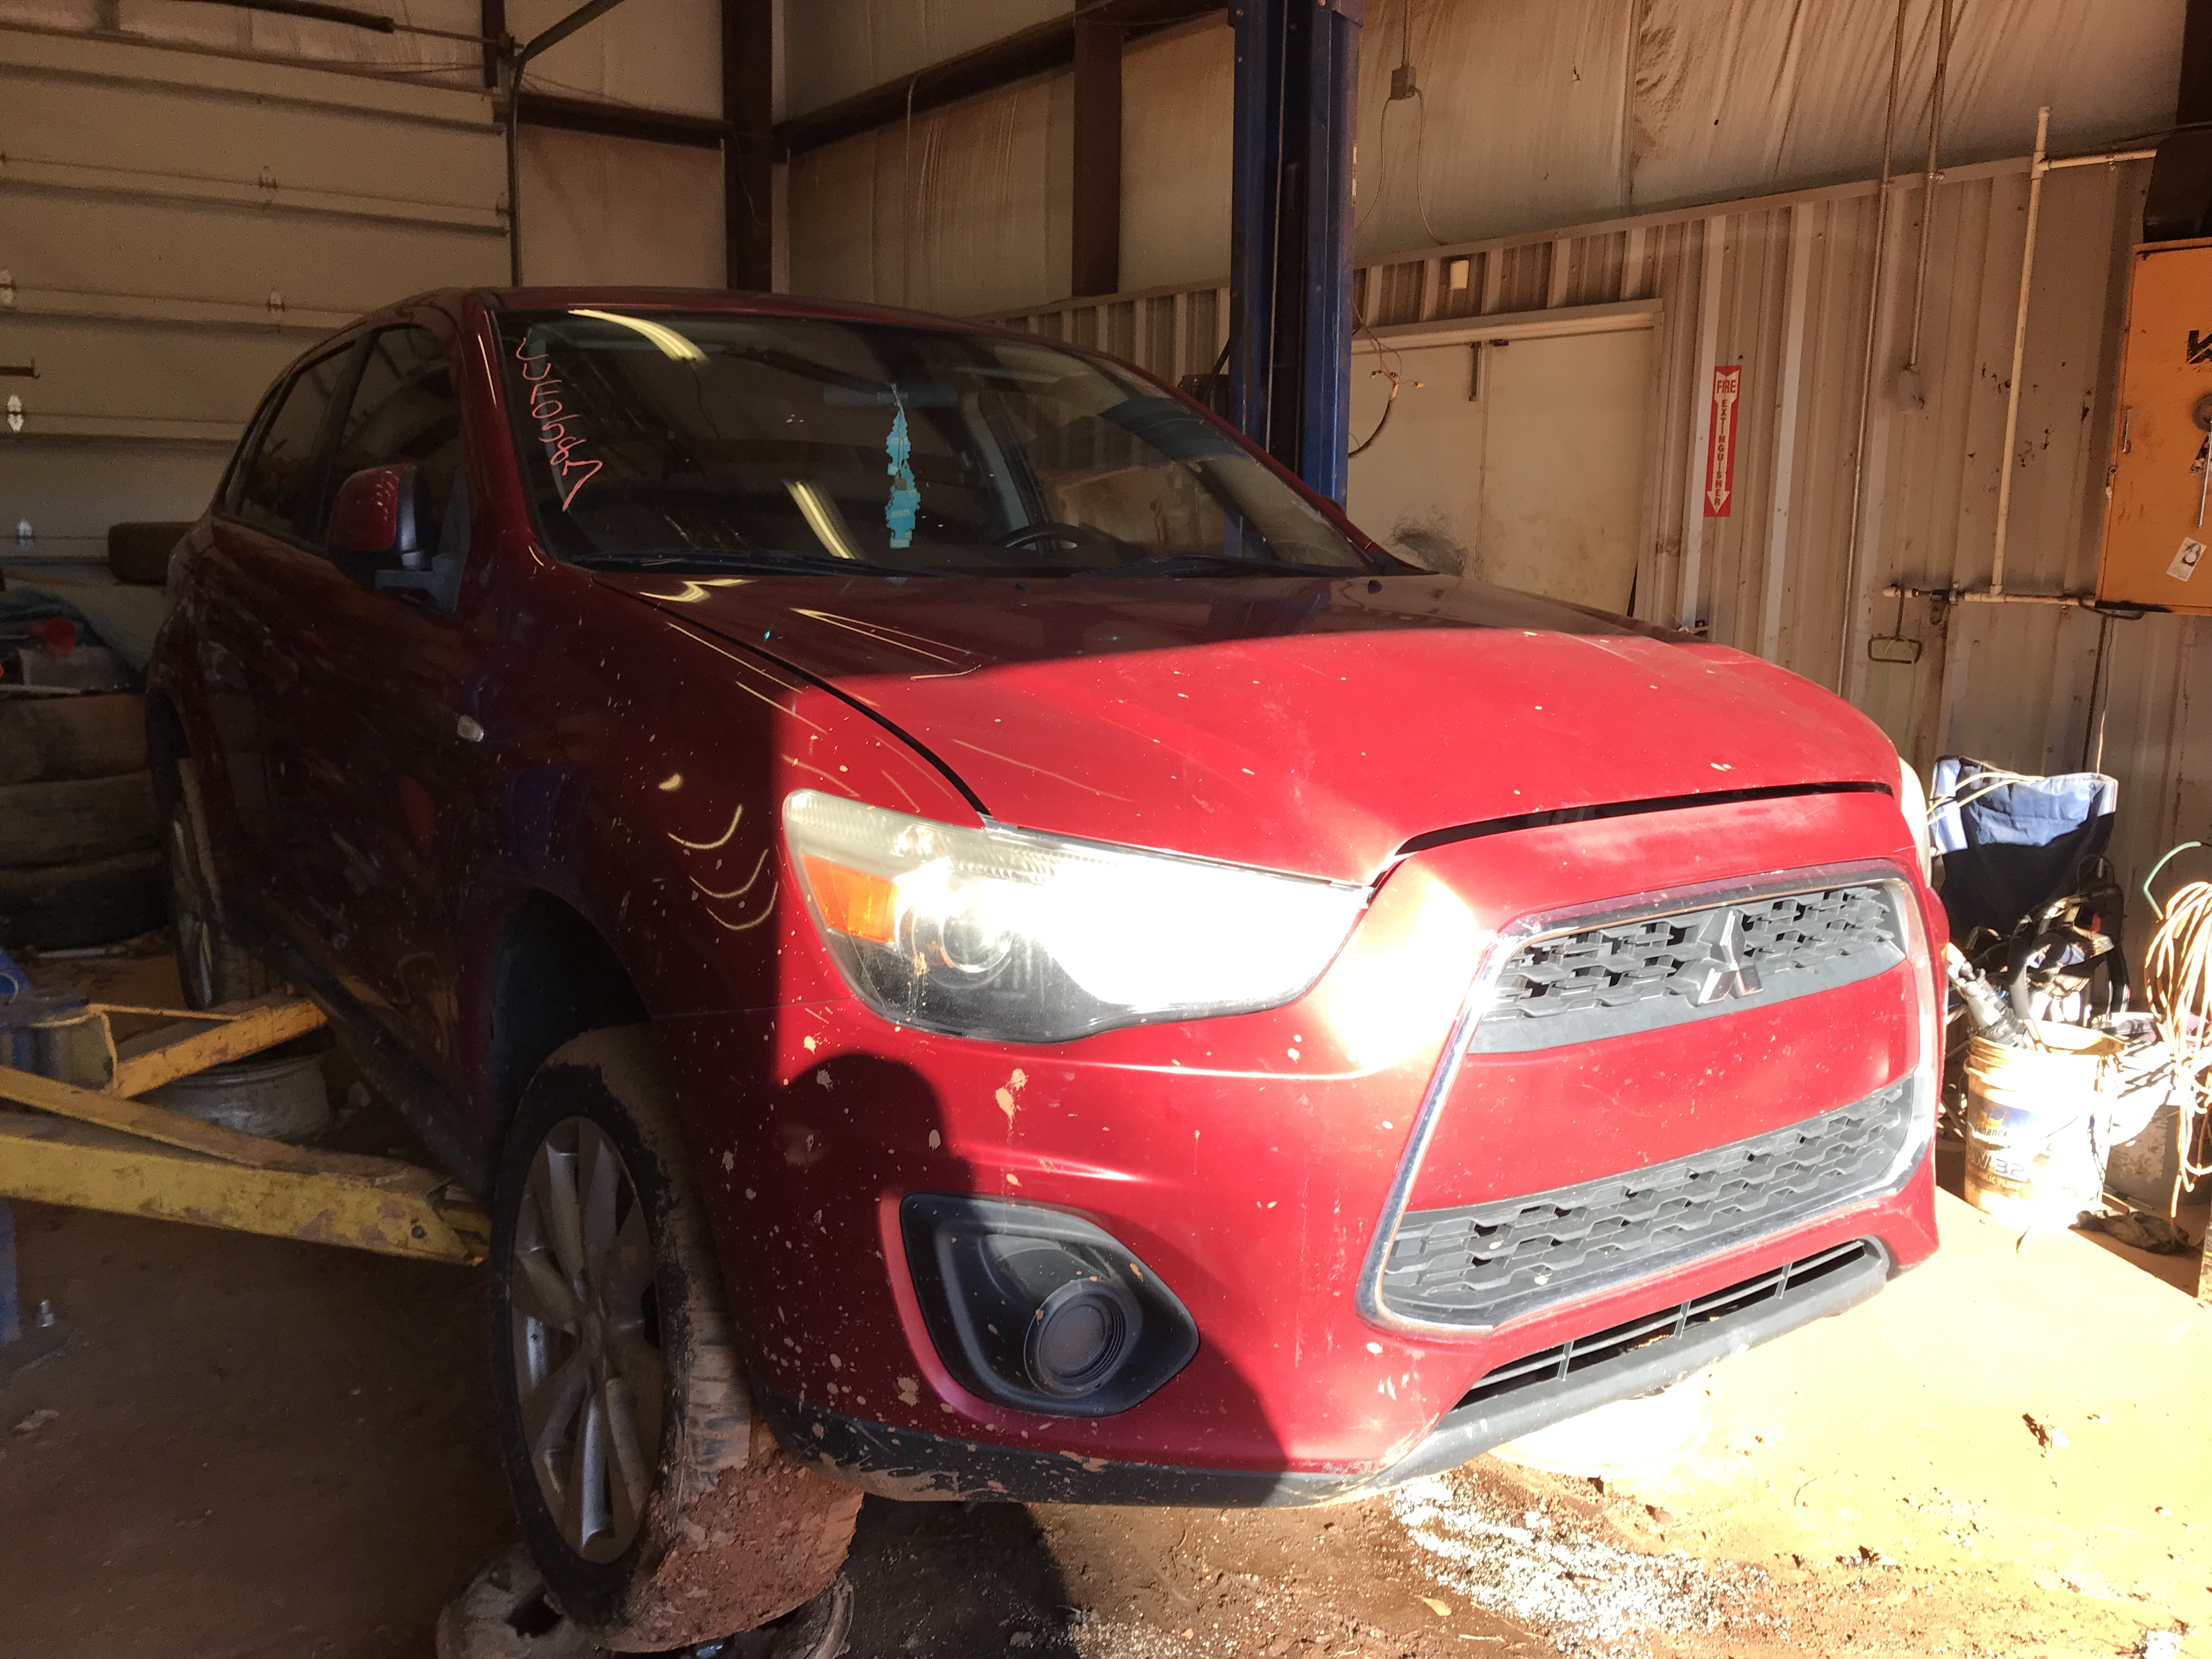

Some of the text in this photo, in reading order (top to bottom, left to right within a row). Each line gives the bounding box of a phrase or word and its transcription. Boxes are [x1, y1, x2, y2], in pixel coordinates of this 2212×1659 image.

[1716, 380, 1736, 394] FIRE
[1714, 399, 1728, 506] EXTINGUISHER
[1994, 1158, 2025, 1178] 32
